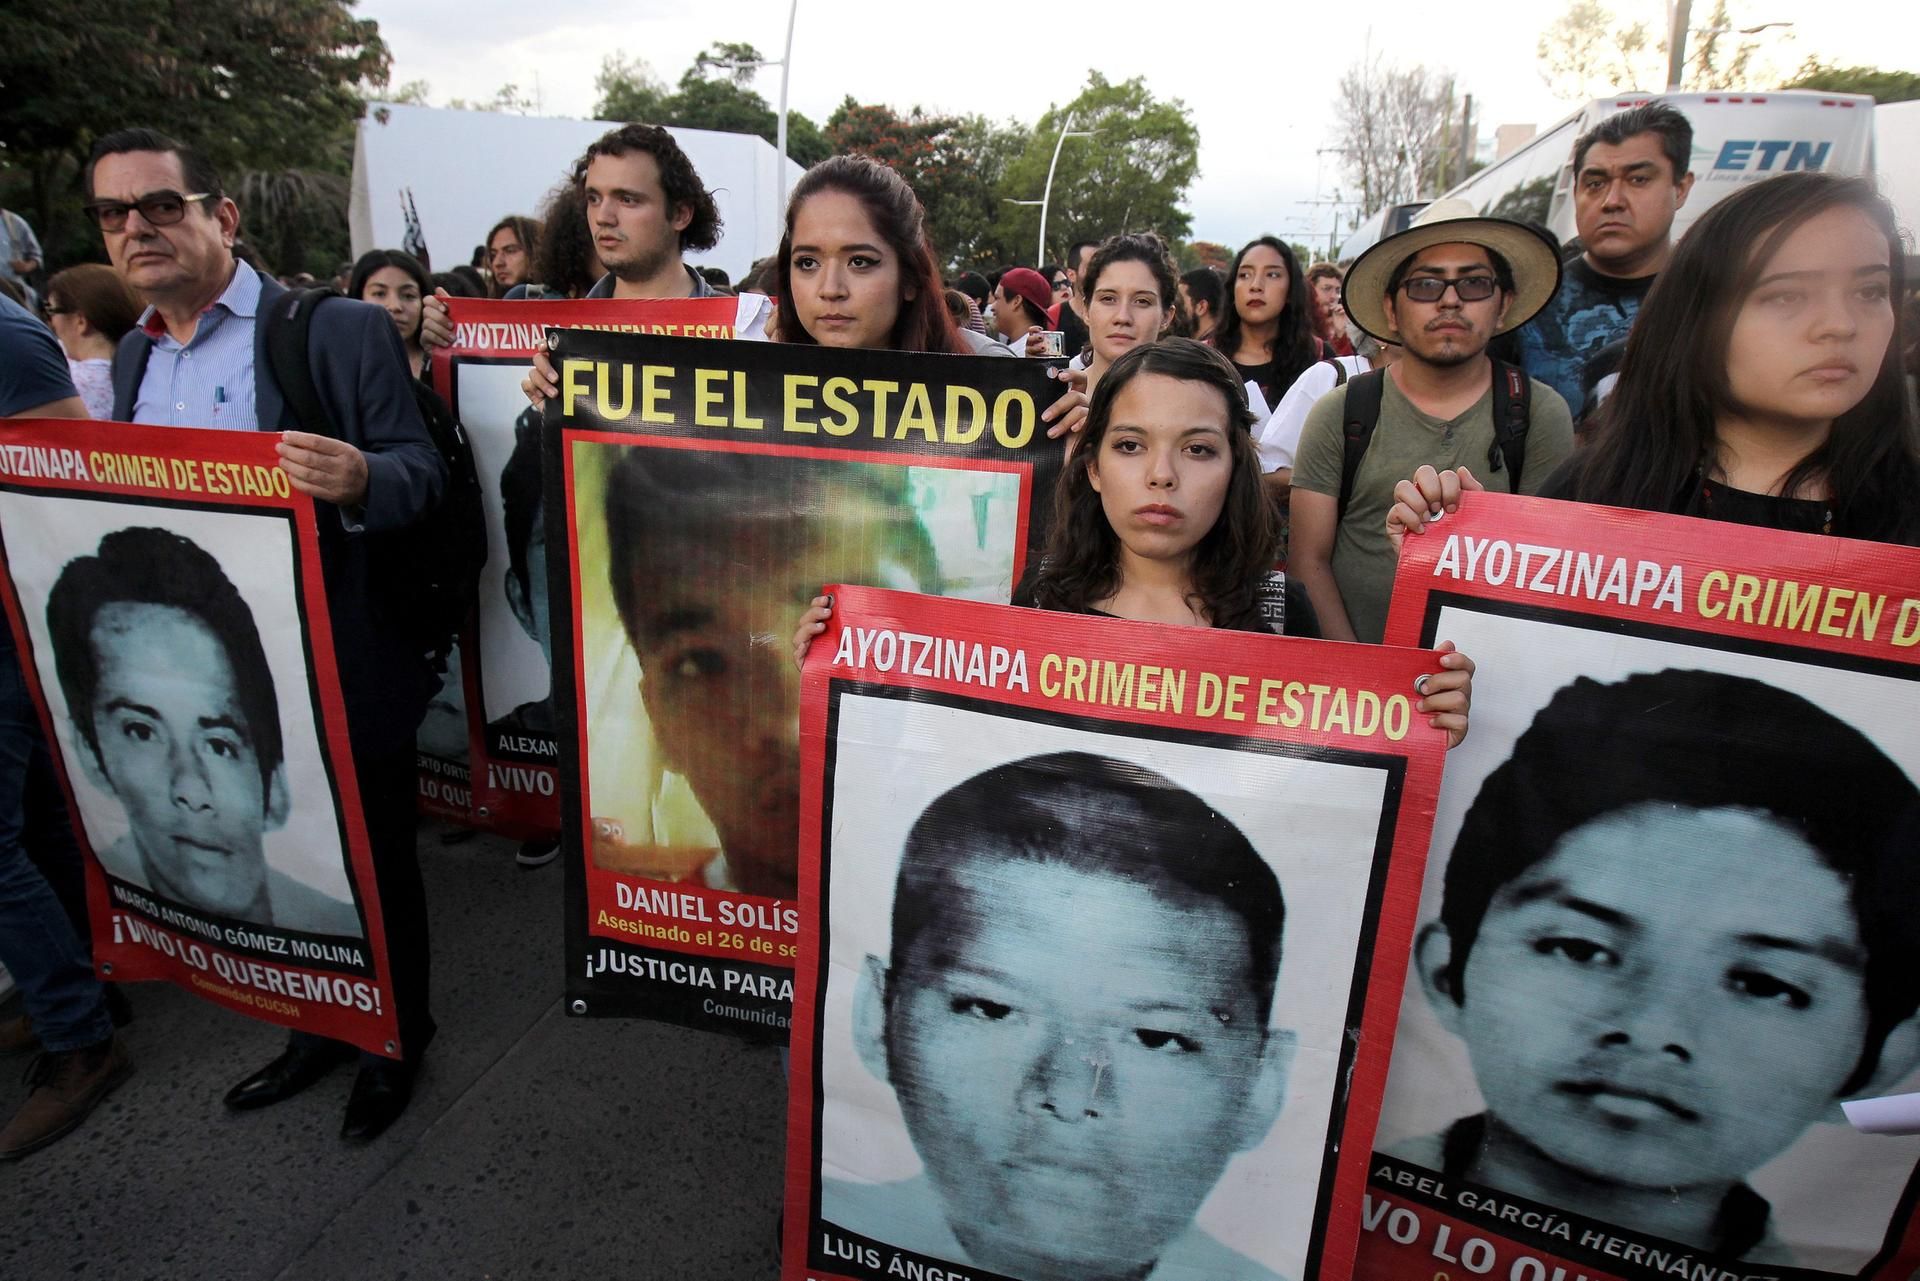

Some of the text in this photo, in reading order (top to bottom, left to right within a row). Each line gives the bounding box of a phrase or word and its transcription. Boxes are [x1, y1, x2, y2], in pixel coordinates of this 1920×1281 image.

[1713, 140, 1832, 170] ETN
[455, 323, 560, 350] AYOTZINA
[563, 359, 1036, 449] FUE EL ESTADO
[90, 451, 169, 489] CRIMEN
[170, 459, 202, 492] DE
[202, 461, 290, 499] ESTADO
[1433, 534, 1920, 647] AYOTZINAPA CRIMEN D
[832, 626, 1410, 741] AYOTZINAPA CRIMEN DE ESTADO
[419, 777, 438, 799] LO
[488, 763, 554, 796] ¡VIVO
[113, 885, 364, 968] MARCO ANTONIO GÓMEZ MOLINA
[597, 910, 690, 943] Asesinado
[695, 930, 713, 946] el
[719, 932, 744, 949] 26
[750, 937, 773, 954] de
[616, 882, 798, 934] DANIEL SOLÍS
[113, 915, 382, 1015] ¡VIVO LO QUEREMOS!
[586, 949, 794, 1002] ¡JUSTICIA PARA
[192, 974, 300, 1017] Comunidad CUCSH
[1374, 1165, 1448, 1200] ABEL
[1457, 1190, 1571, 1240] GARCÍA
[823, 1233, 881, 1269] LUIS
[1432, 1224, 1496, 1274] LO
